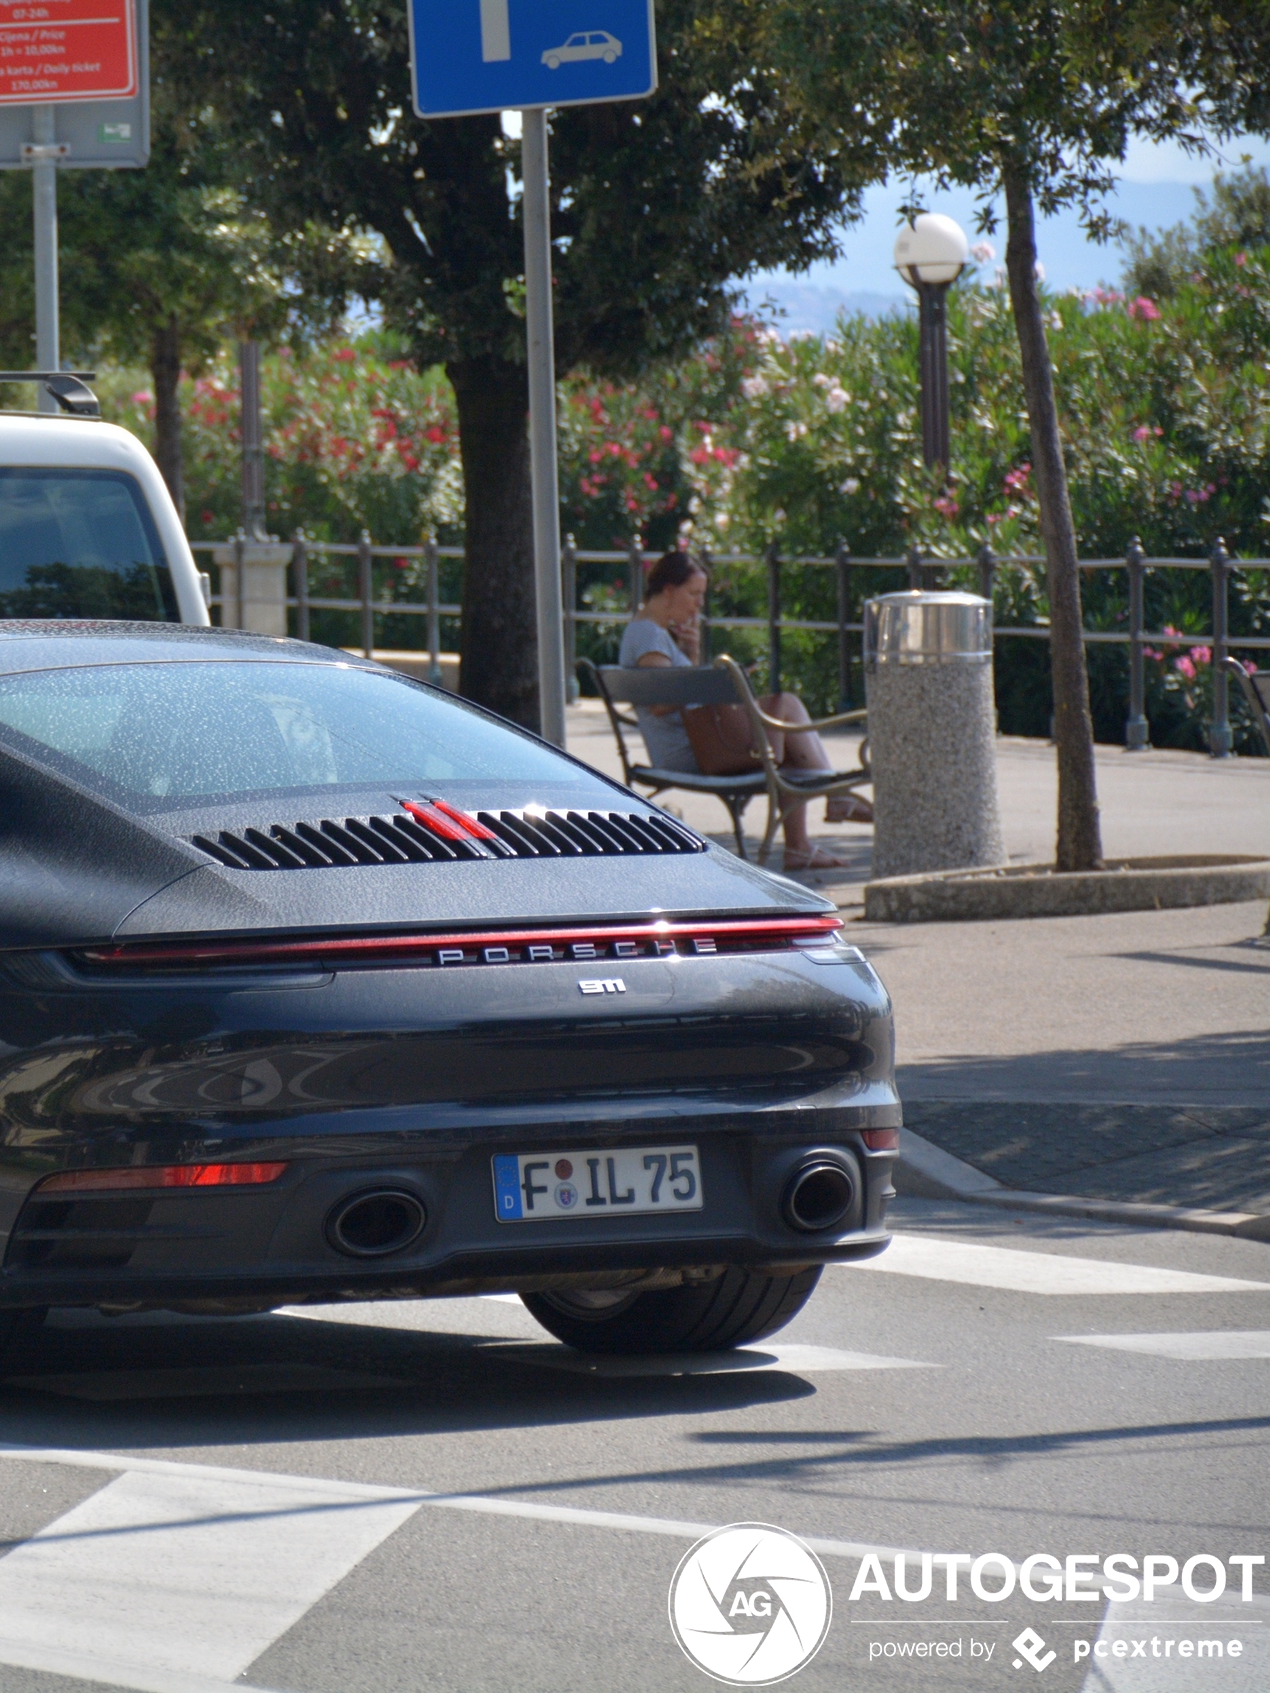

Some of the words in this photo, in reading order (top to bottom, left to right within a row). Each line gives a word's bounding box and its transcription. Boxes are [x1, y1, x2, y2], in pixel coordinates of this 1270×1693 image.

[40, 30, 65, 40] Price
[6, 65, 34, 76] karta
[43, 63, 70, 75] Daily
[72, 62, 100, 73] ticket
[439, 938, 717, 965] PORSCHE
[578, 978, 627, 994] 911
[523, 1161, 550, 1210] F
[586, 1157, 635, 1206] IL
[643, 1152, 696, 1203] 75
[505, 1195, 514, 1209] D
